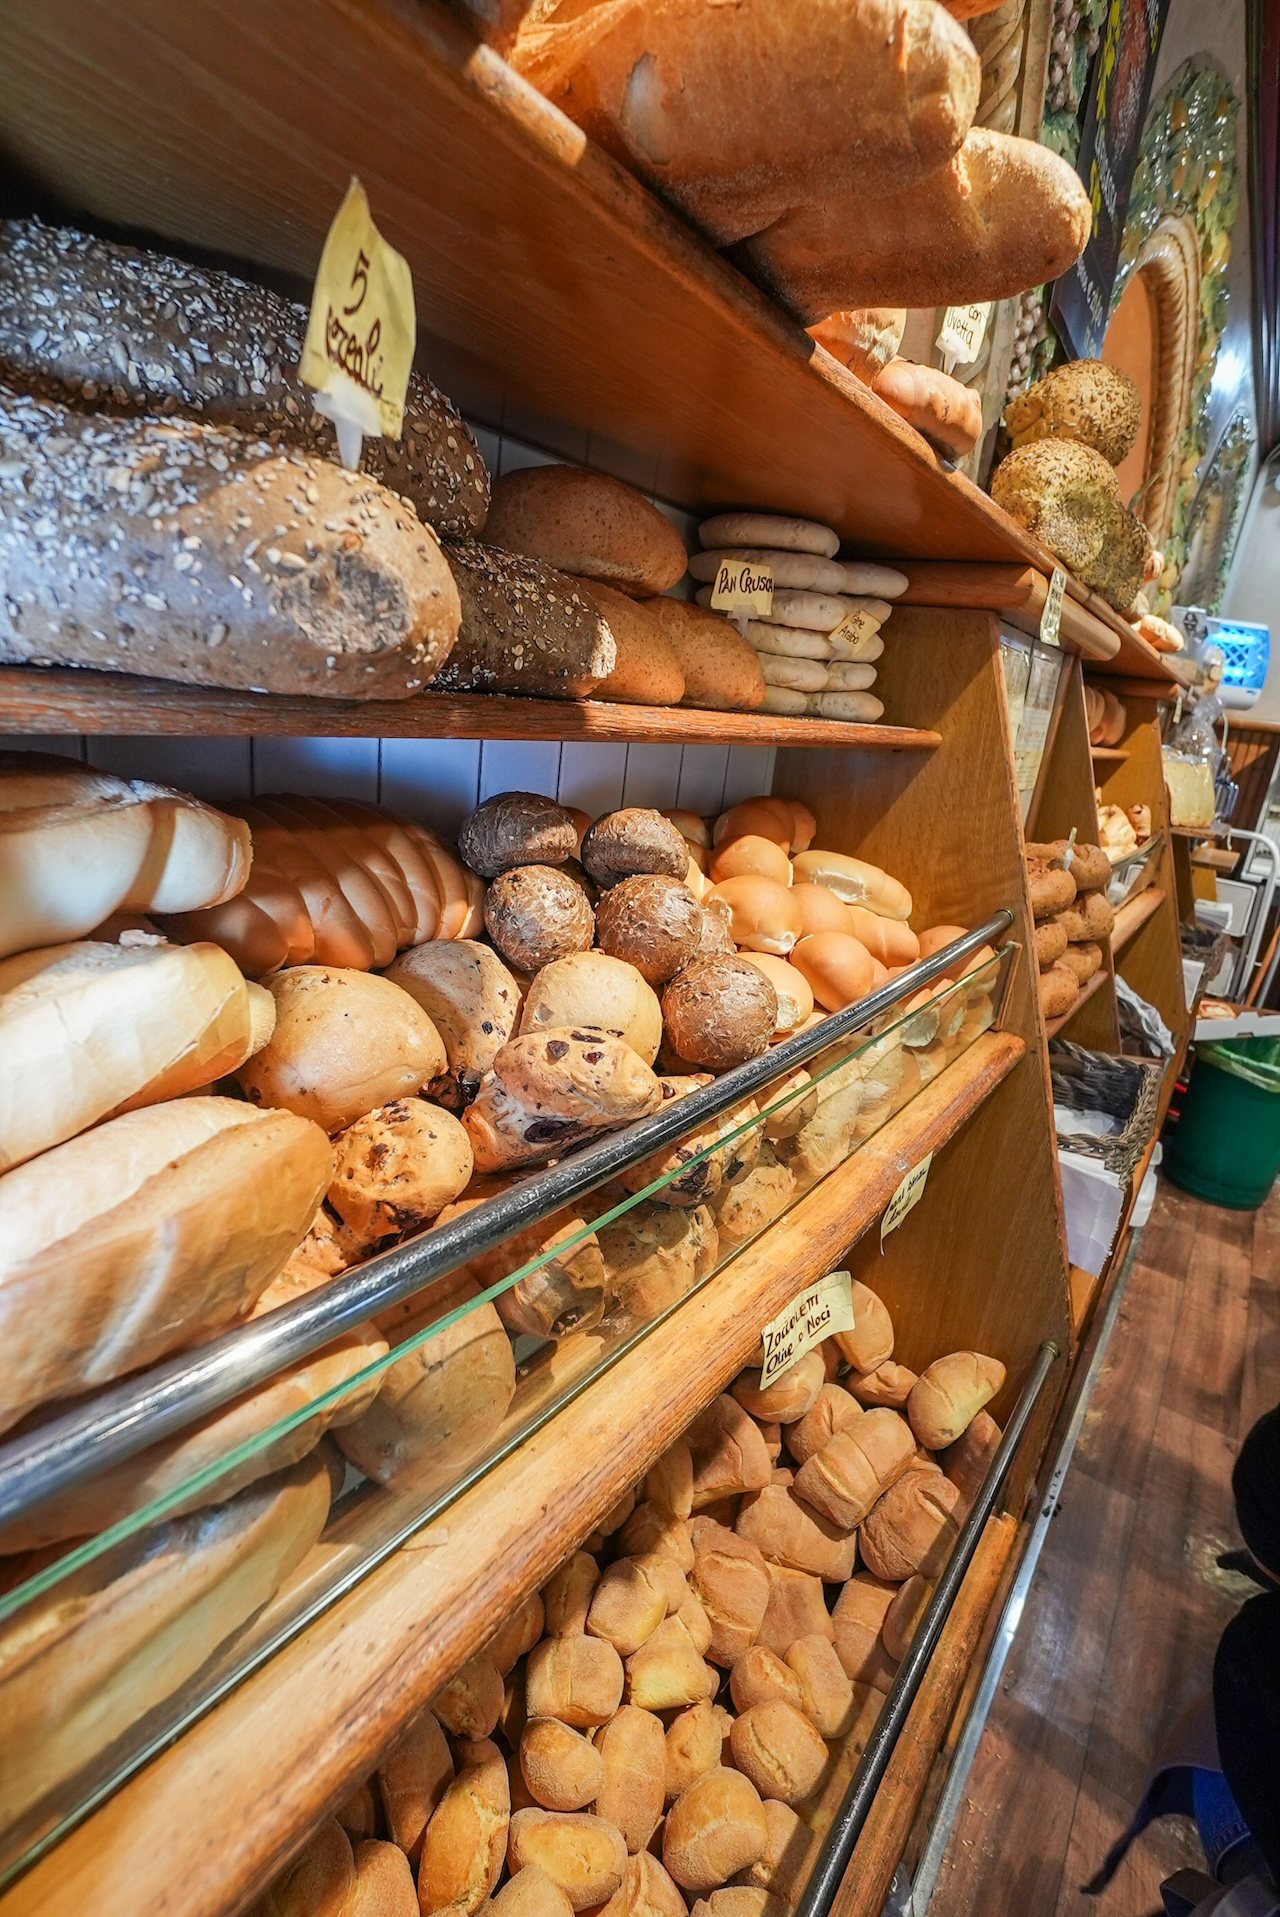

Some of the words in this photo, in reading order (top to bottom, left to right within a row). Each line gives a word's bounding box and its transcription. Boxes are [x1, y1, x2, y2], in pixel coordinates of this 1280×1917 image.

[343, 248, 370, 316] 5
[718, 567, 737, 594] PAN
[766, 1342, 793, 1375] Olive
[806, 1304, 831, 1334] Noci
